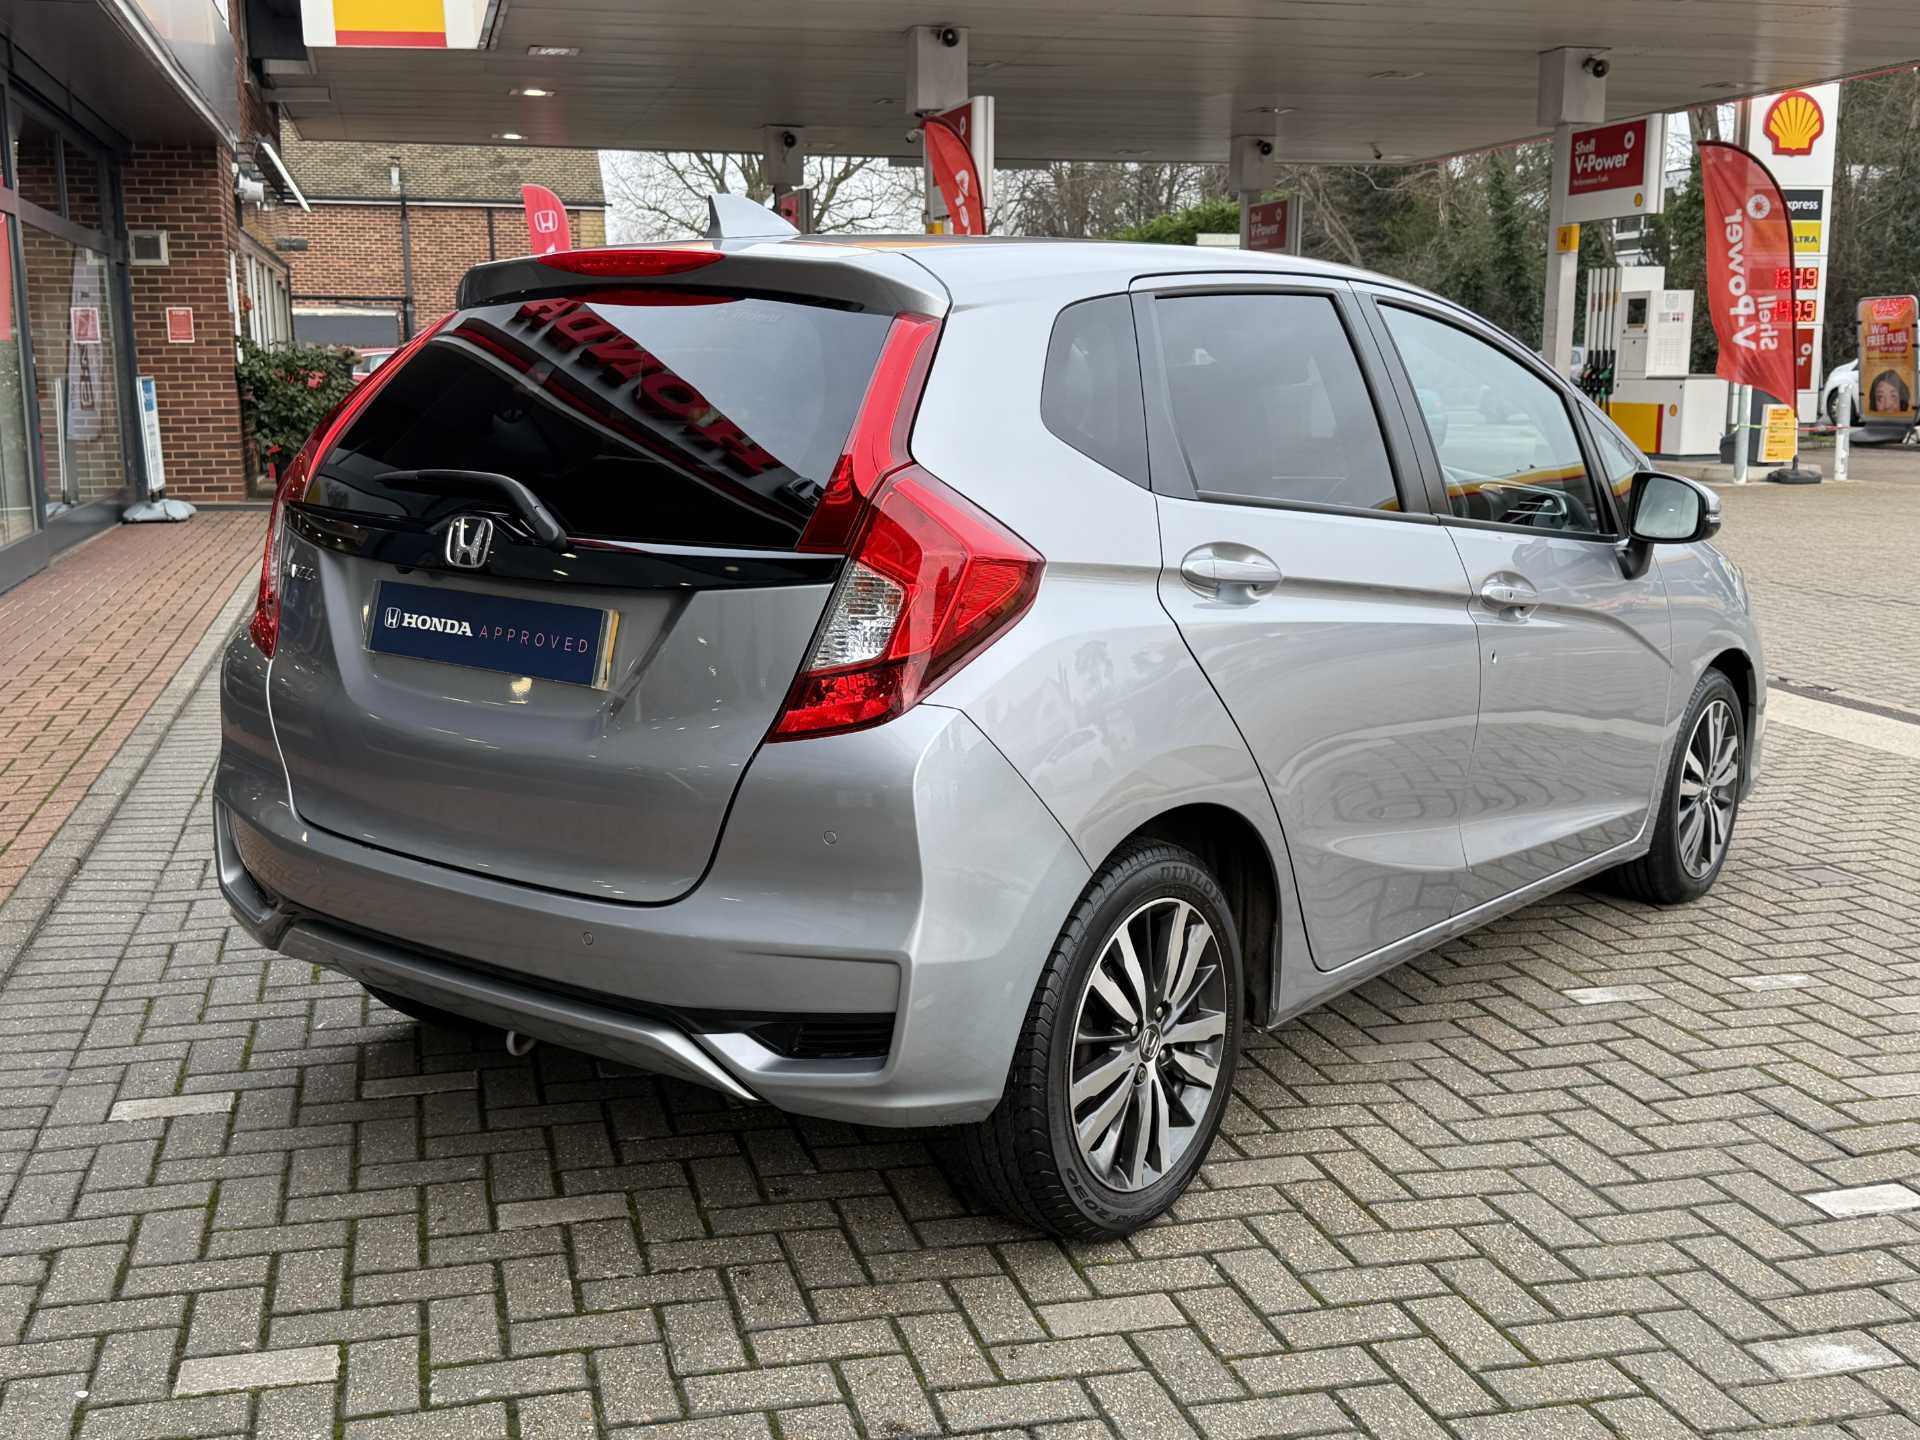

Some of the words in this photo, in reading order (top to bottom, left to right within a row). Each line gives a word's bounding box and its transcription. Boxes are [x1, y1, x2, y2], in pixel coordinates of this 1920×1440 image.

[1575, 138, 1596, 154] Shell
[1575, 151, 1629, 175] V-Power
[1786, 199, 1819, 211] xpress
[1794, 234, 1817, 245] LTRA
[401, 612, 473, 637] HONDA
[478, 624, 588, 653] APPROVED
